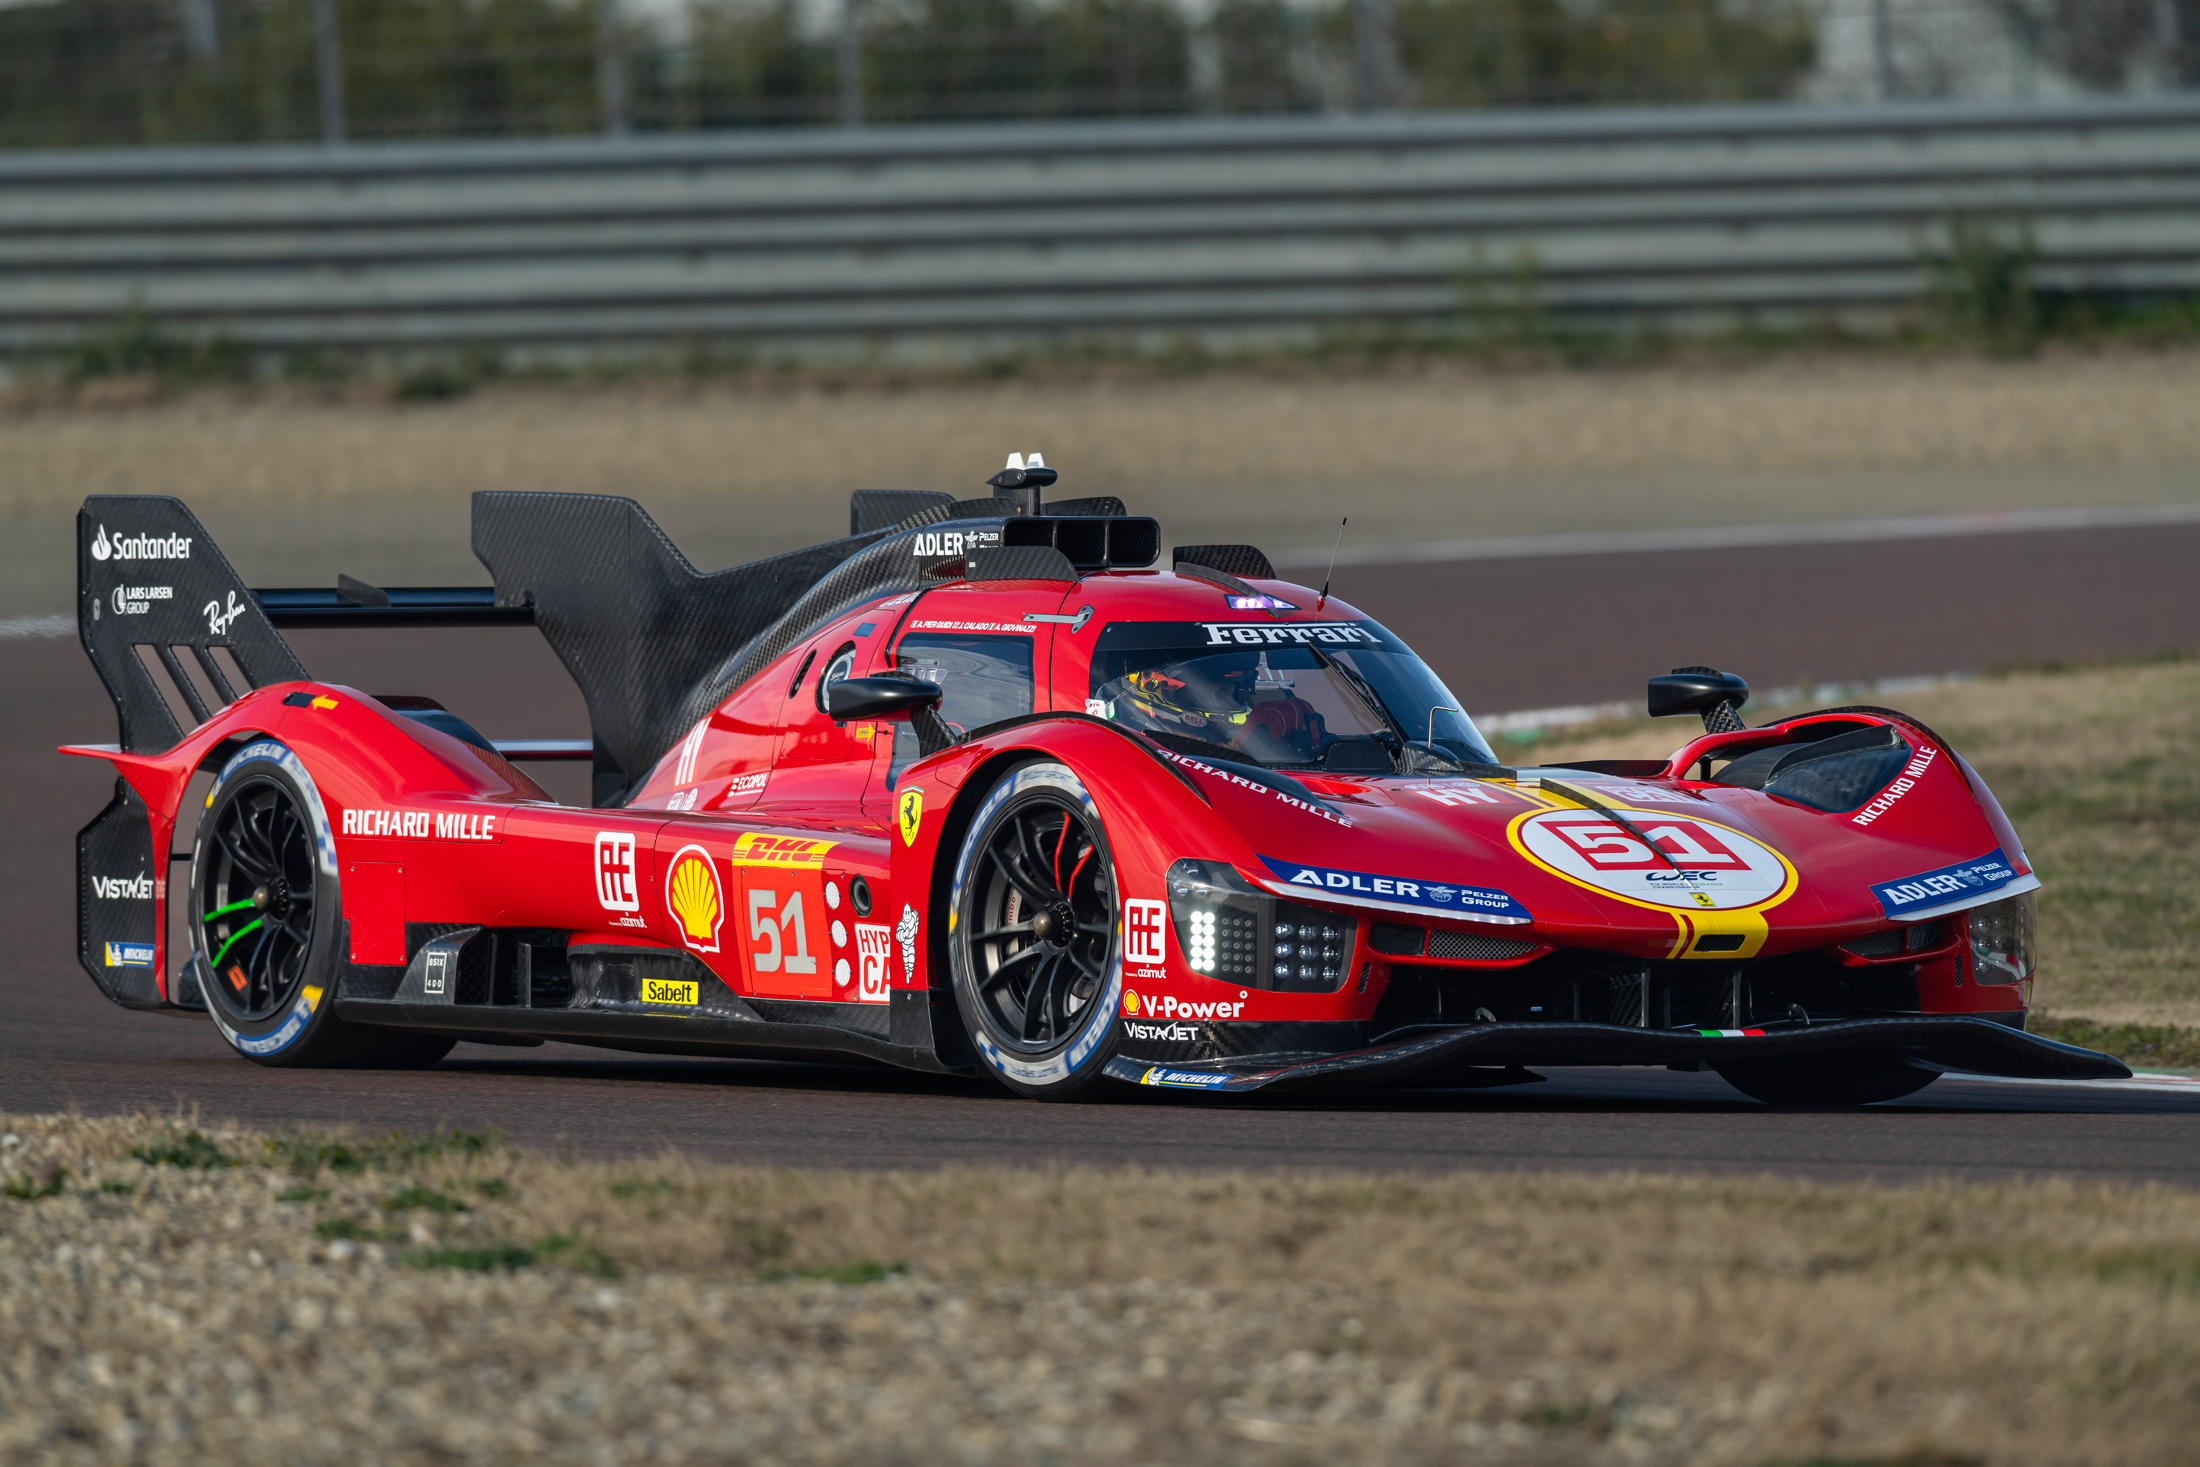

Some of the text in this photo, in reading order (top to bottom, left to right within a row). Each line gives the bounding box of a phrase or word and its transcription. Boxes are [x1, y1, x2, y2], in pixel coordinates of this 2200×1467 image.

[112, 531, 192, 560] Santander
[913, 532, 999, 556] ADLER PELZER
[126, 587, 173, 599] LARS LARSEN
[126, 603, 150, 614] GROUP
[203, 590, 246, 636] Ray-Ban
[936, 621, 952, 629] GUIDI
[964, 622, 988, 630] CALADO
[1001, 623, 1037, 633] GIOVINAZZI
[1202, 623, 1383, 645] Ferrari
[1184, 714, 1204, 725] BELL
[674, 716, 713, 787] HY
[737, 773, 768, 790] ECOPOL
[1156, 749, 1354, 829] RICHARD MILLE
[1852, 745, 1937, 826] RICHARD MILLE
[1415, 788, 1500, 806] HY
[342, 809, 497, 841] RICHARD MILLE
[746, 836, 820, 862] DHL
[1555, 825, 1736, 863] 51
[1290, 869, 1509, 901] ADLER PELZER
[1646, 871, 1717, 881] WEC
[1882, 862, 2002, 905] ADLER PELZER
[1983, 869, 2013, 881] GROUP
[1461, 896, 1510, 908] GROUP
[748, 888, 817, 975] 51
[858, 928, 891, 955] HYP
[1138, 963, 1167, 979] azimut
[427, 979, 442, 988] 400
[647, 981, 693, 1003] Sabelt
[1141, 996, 1245, 1018] V-Power
[1163, 1072, 1228, 1085] MICHELIN
